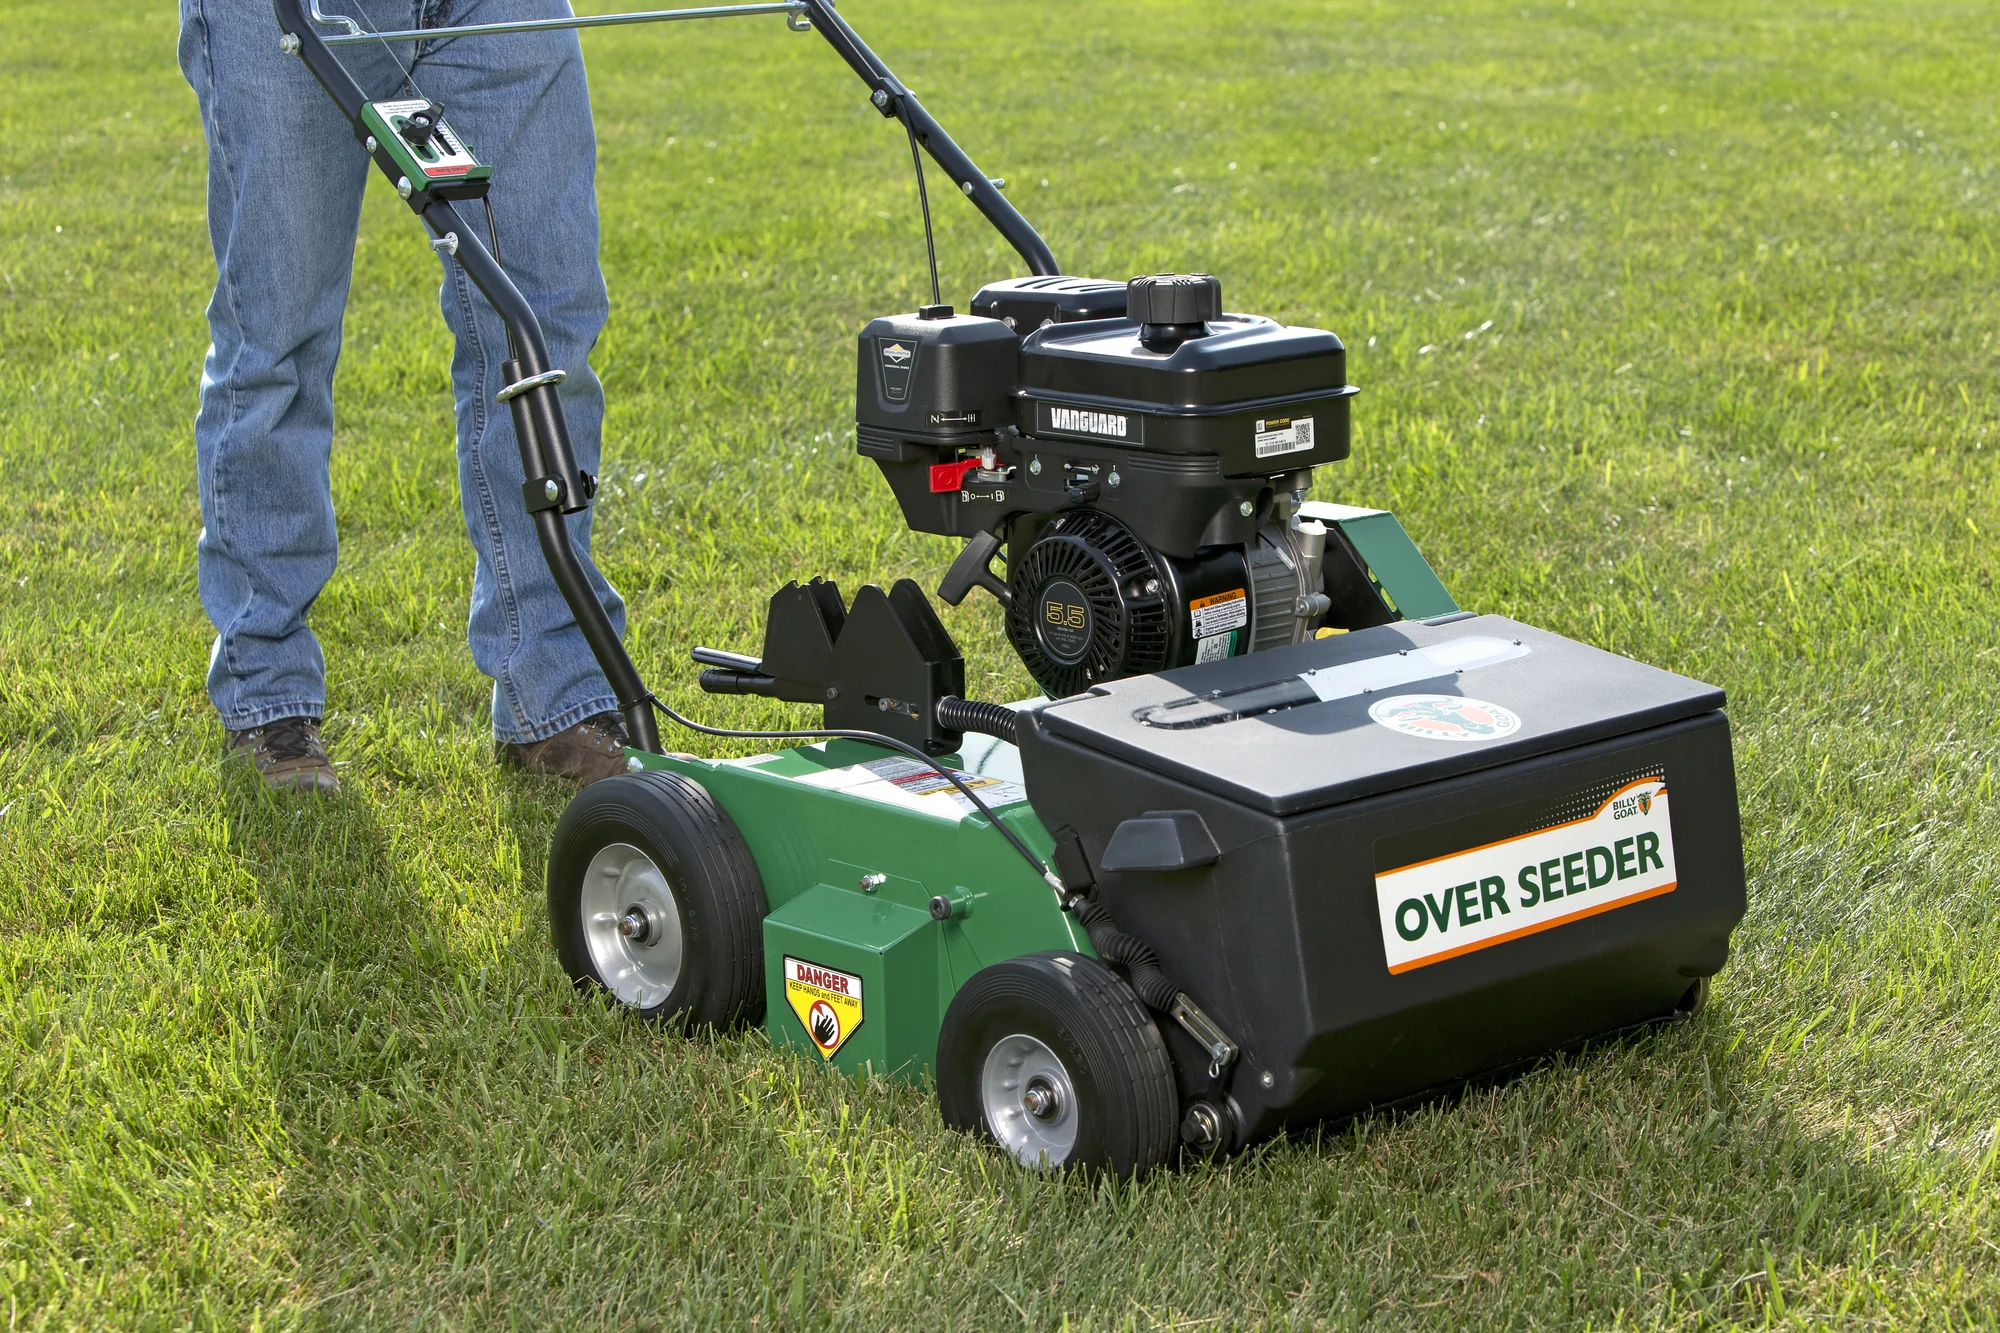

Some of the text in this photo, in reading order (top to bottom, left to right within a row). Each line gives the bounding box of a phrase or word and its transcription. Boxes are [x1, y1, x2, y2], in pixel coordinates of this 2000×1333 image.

[1050, 407, 1127, 437] VANGUARD
[1208, 592, 1237, 605] WARNING
[1046, 600, 1085, 629] 5.5
[1477, 705, 1511, 728] GOAT
[1398, 723, 1471, 738] BILLY
[1612, 796, 1637, 811] BILLY
[1613, 806, 1638, 820] GOAT
[1394, 831, 1664, 942] OVER SEEDER
[796, 964, 850, 995] DANGER
[789, 981, 859, 1008] KEEP HANDS and FEET AWAY
